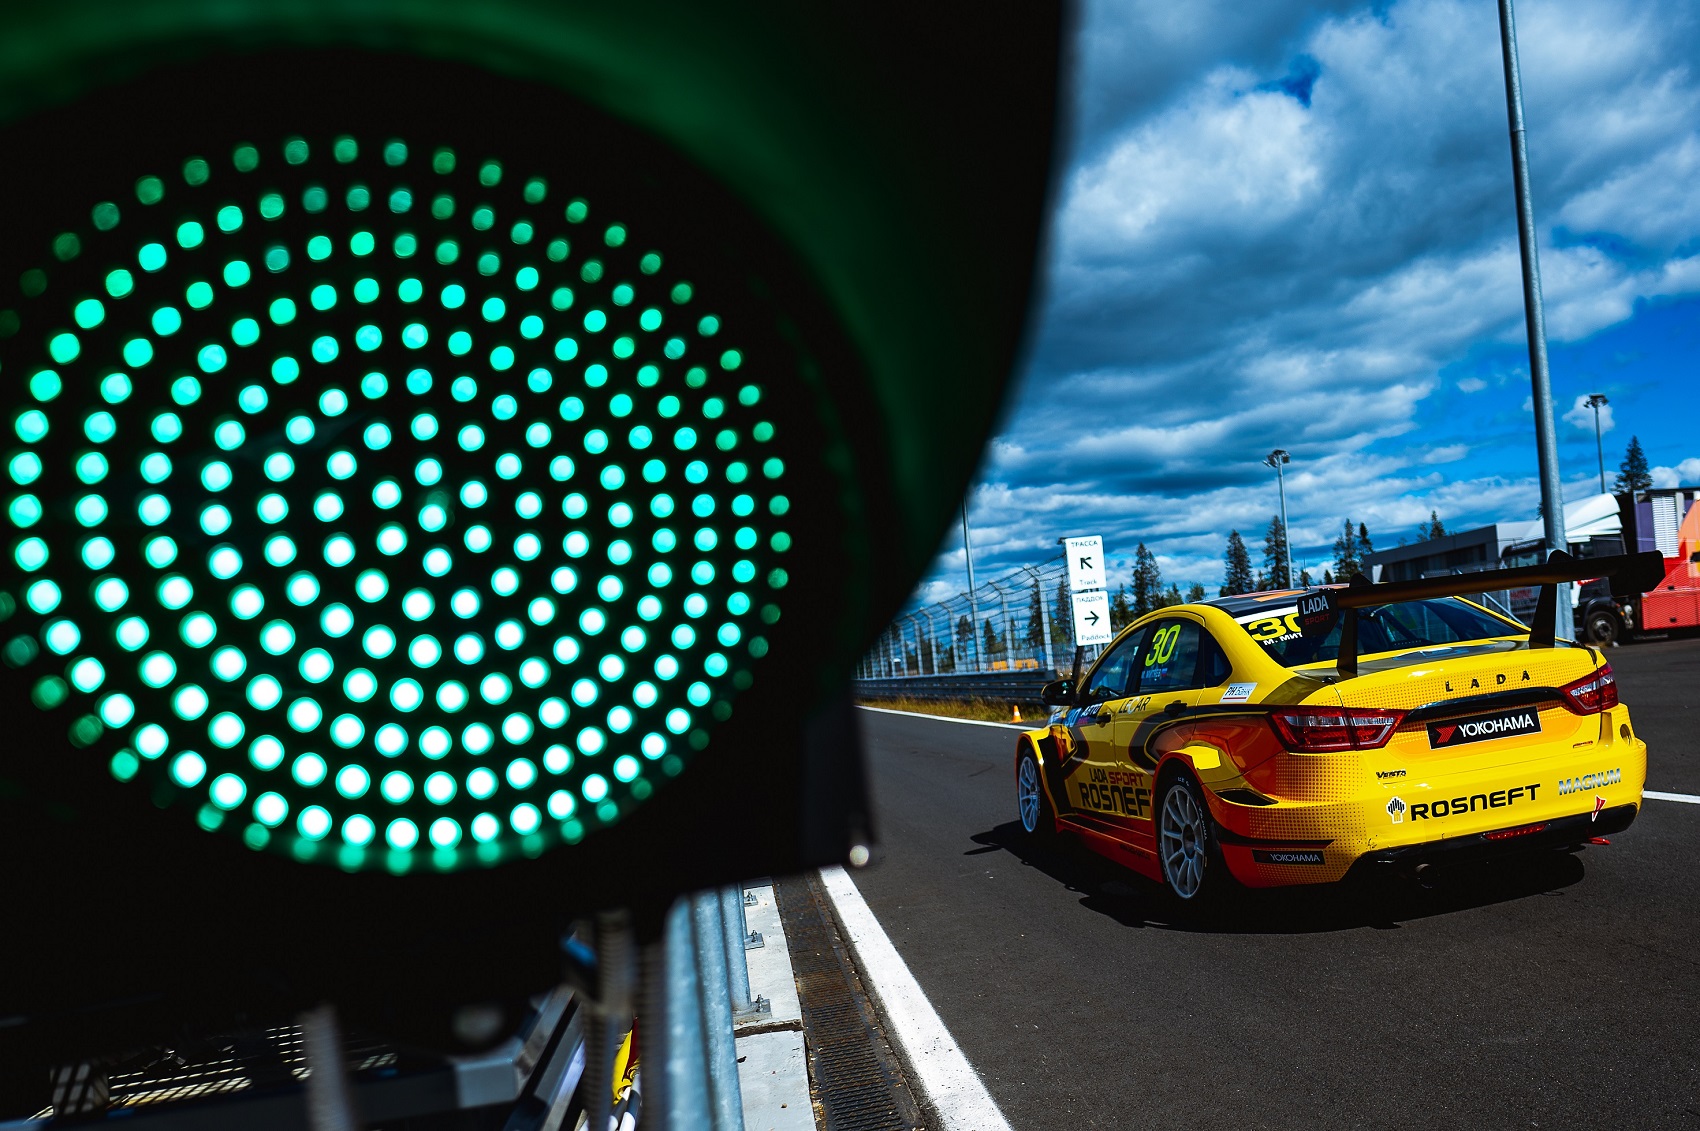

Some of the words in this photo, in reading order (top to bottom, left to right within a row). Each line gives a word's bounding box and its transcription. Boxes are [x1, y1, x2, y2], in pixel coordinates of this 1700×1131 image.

[1302, 595, 1329, 615] LADA
[1304, 613, 1330, 626] SPORT
[1081, 633, 1110, 641] Paddock
[1145, 624, 1181, 667] 30
[1445, 670, 1530, 692] LADA
[1119, 696, 1151, 714] LECAR
[1458, 713, 1534, 737] YOKOHAMA
[1089, 768, 1108, 783] LADA
[1108, 772, 1144, 786] SPORT
[1559, 768, 1621, 795] MAGNUM
[1078, 782, 1151, 816] ROSNEF
[1410, 783, 1541, 821] ROSNEFT
[1270, 853, 1320, 862] YOKOHAMA
